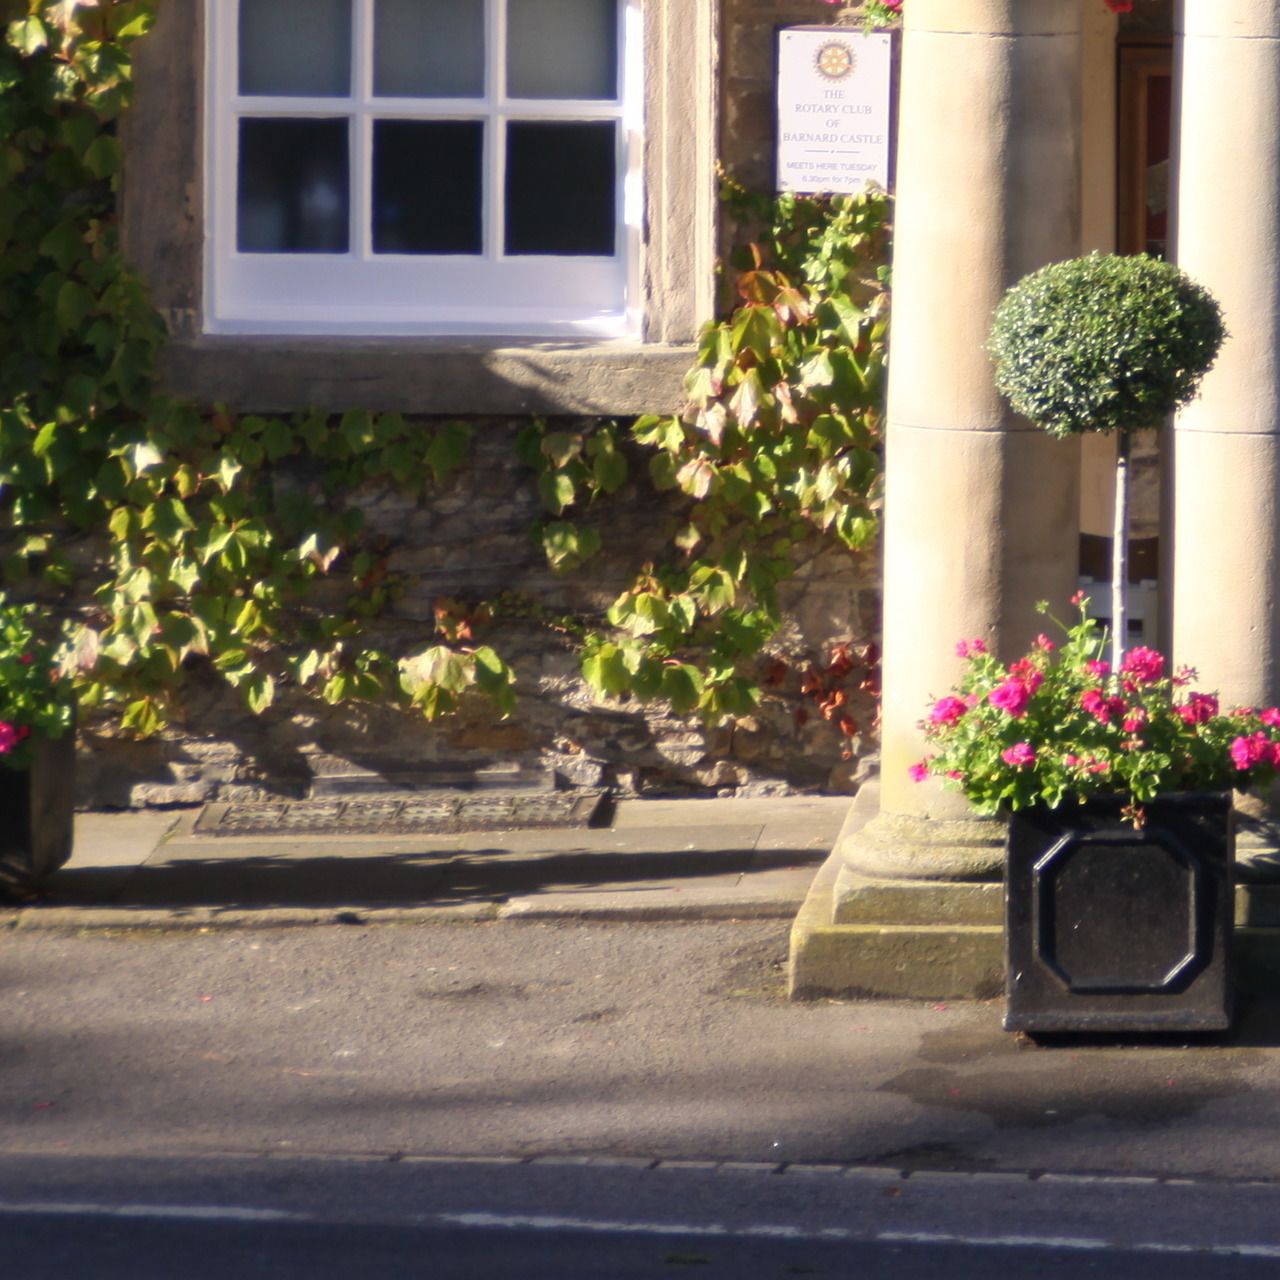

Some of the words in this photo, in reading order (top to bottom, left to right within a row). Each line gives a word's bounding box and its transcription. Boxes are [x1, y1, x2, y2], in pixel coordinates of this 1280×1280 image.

[824, 89, 846, 99] THE
[795, 104, 840, 114] ROTARY
[841, 105, 872, 115] CLUB
[825, 119, 840, 128] OF
[783, 133, 838, 143] BARNARD
[840, 135, 883, 144] CASTLE
[787, 162, 814, 170] MEETS
[840, 163, 877, 171] TUESDAY
